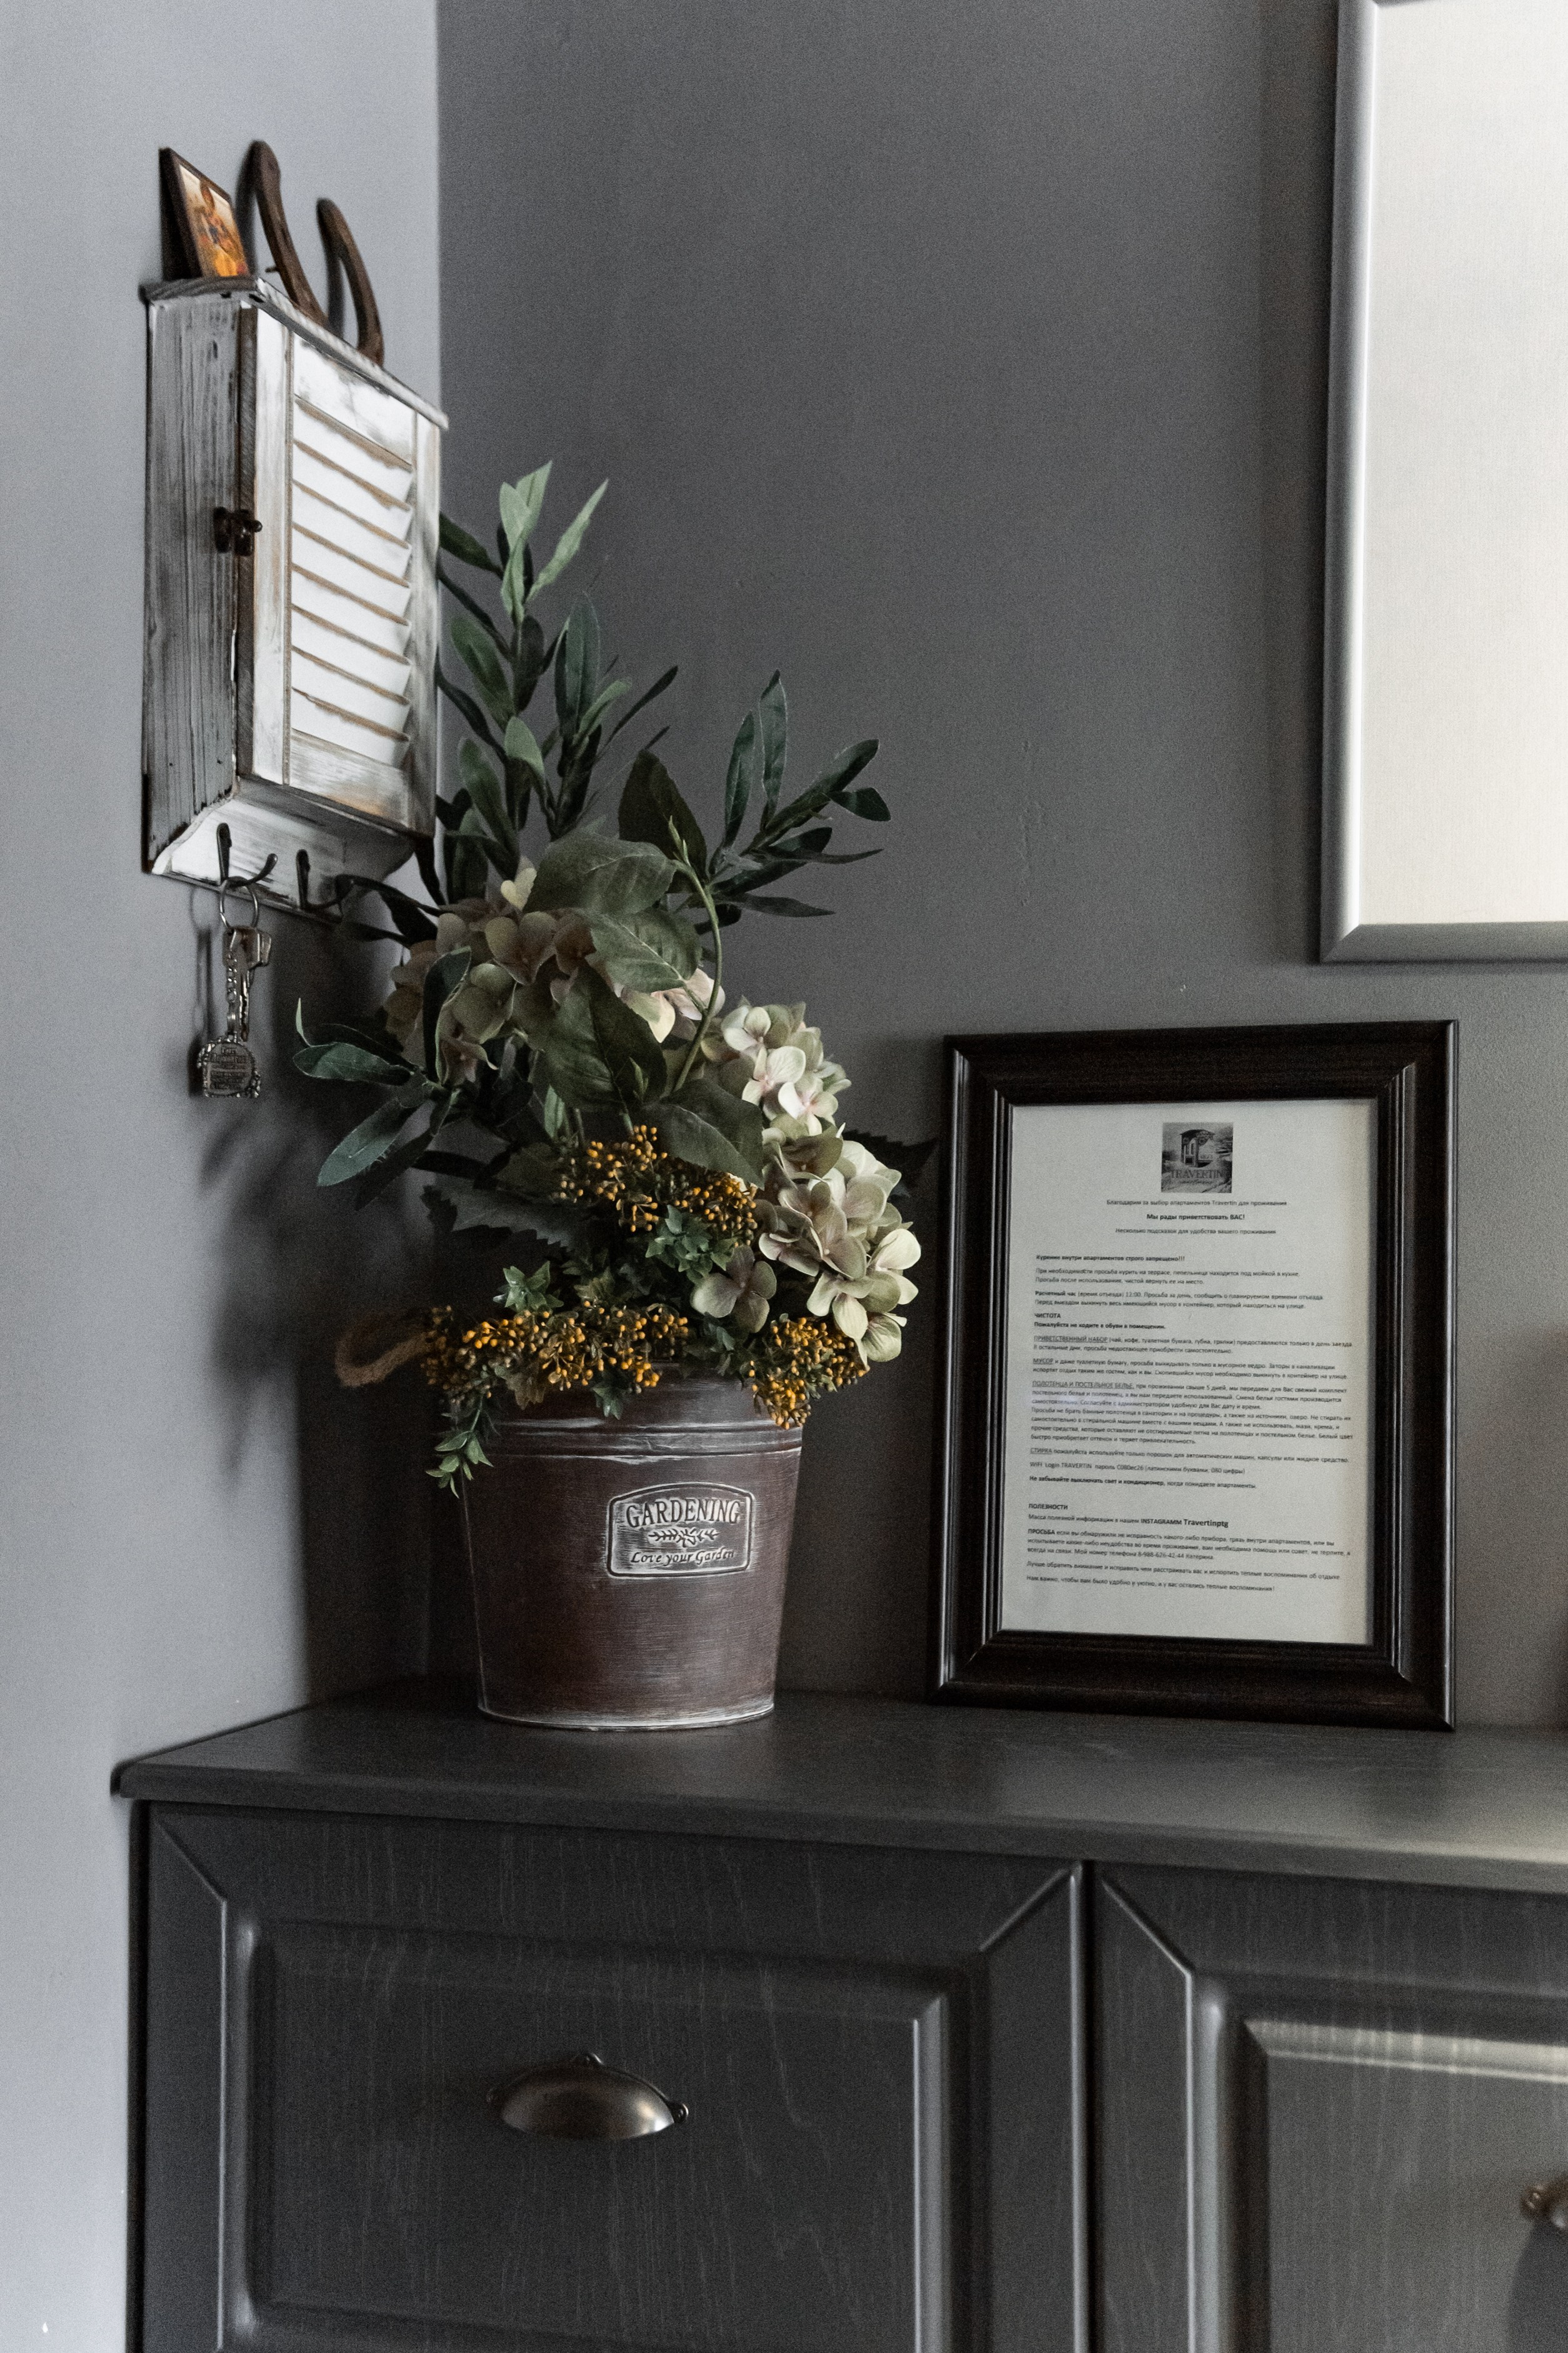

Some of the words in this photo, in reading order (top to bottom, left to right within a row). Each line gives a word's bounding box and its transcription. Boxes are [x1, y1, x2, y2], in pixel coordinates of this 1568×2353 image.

[626, 1498, 741, 1528] GARDENING
[631, 1552, 661, 1563] Love
[666, 1552, 692, 1566] your
[695, 1547, 734, 1565] Garden
